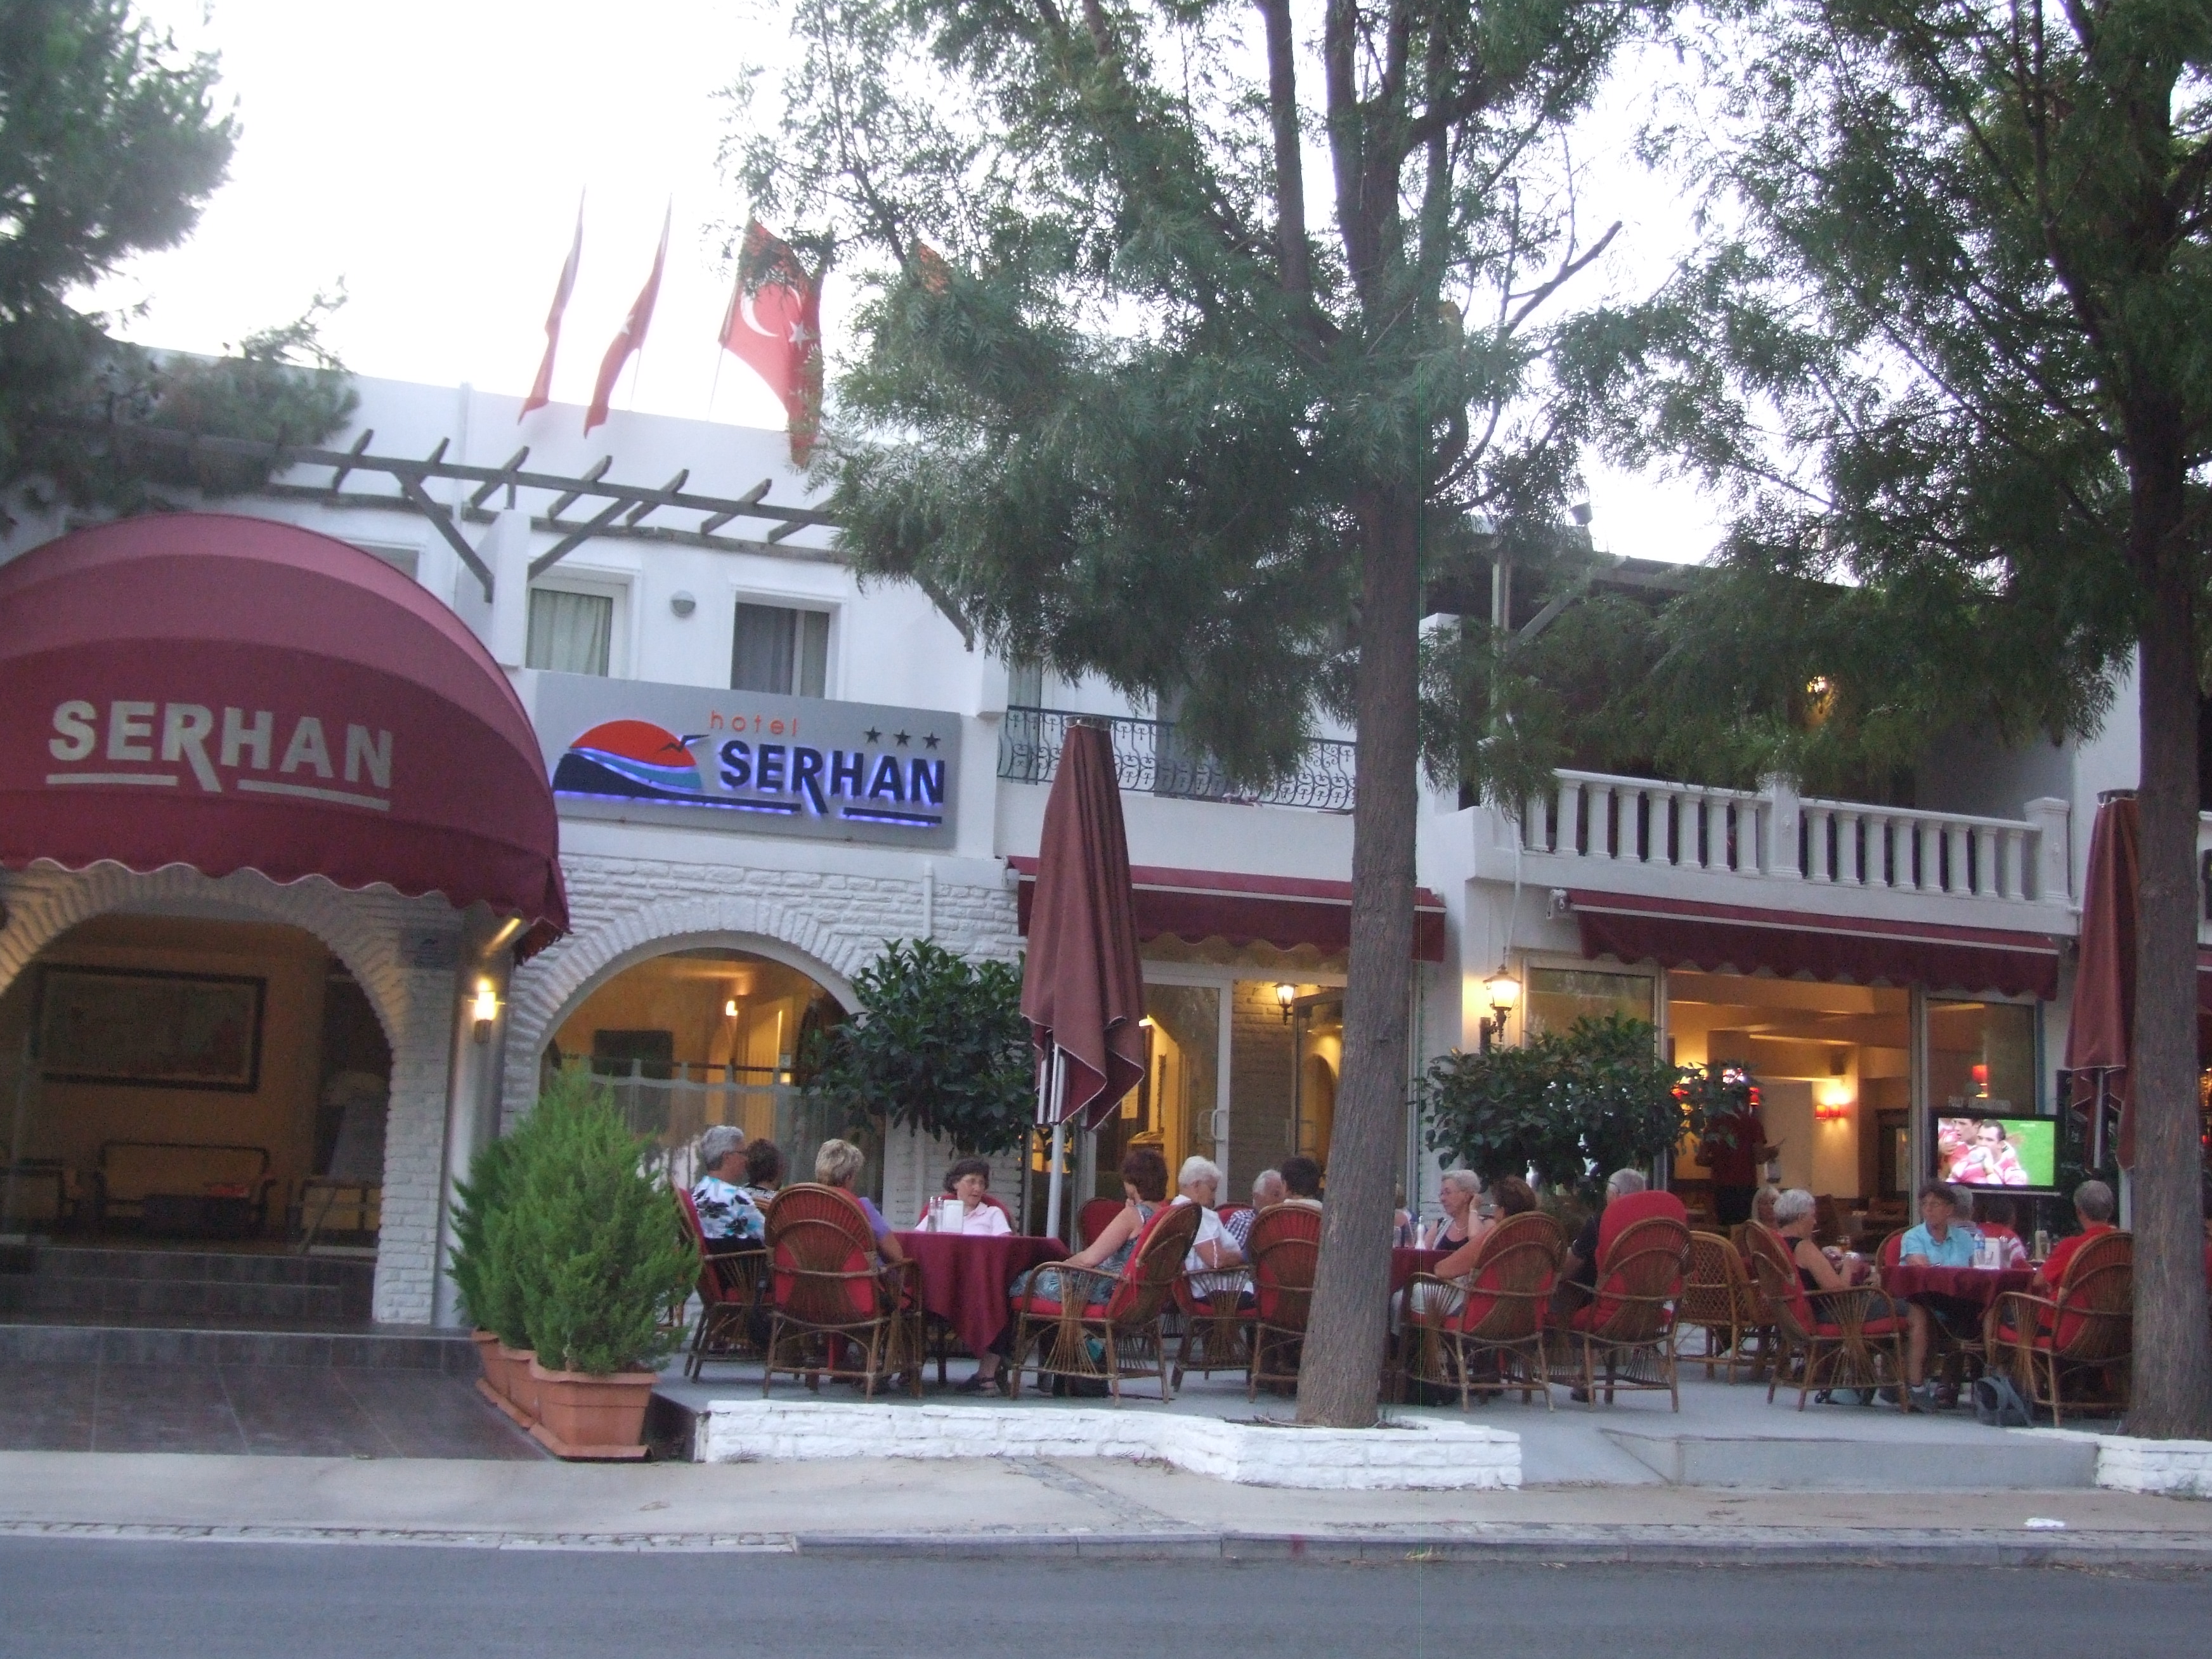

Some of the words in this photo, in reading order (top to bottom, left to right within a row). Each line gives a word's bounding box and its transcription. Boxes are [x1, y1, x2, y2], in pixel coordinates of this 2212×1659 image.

[48, 699, 393, 793] SERHAN
[710, 710, 797, 737] hotel
[720, 739, 945, 814] SERHAN
